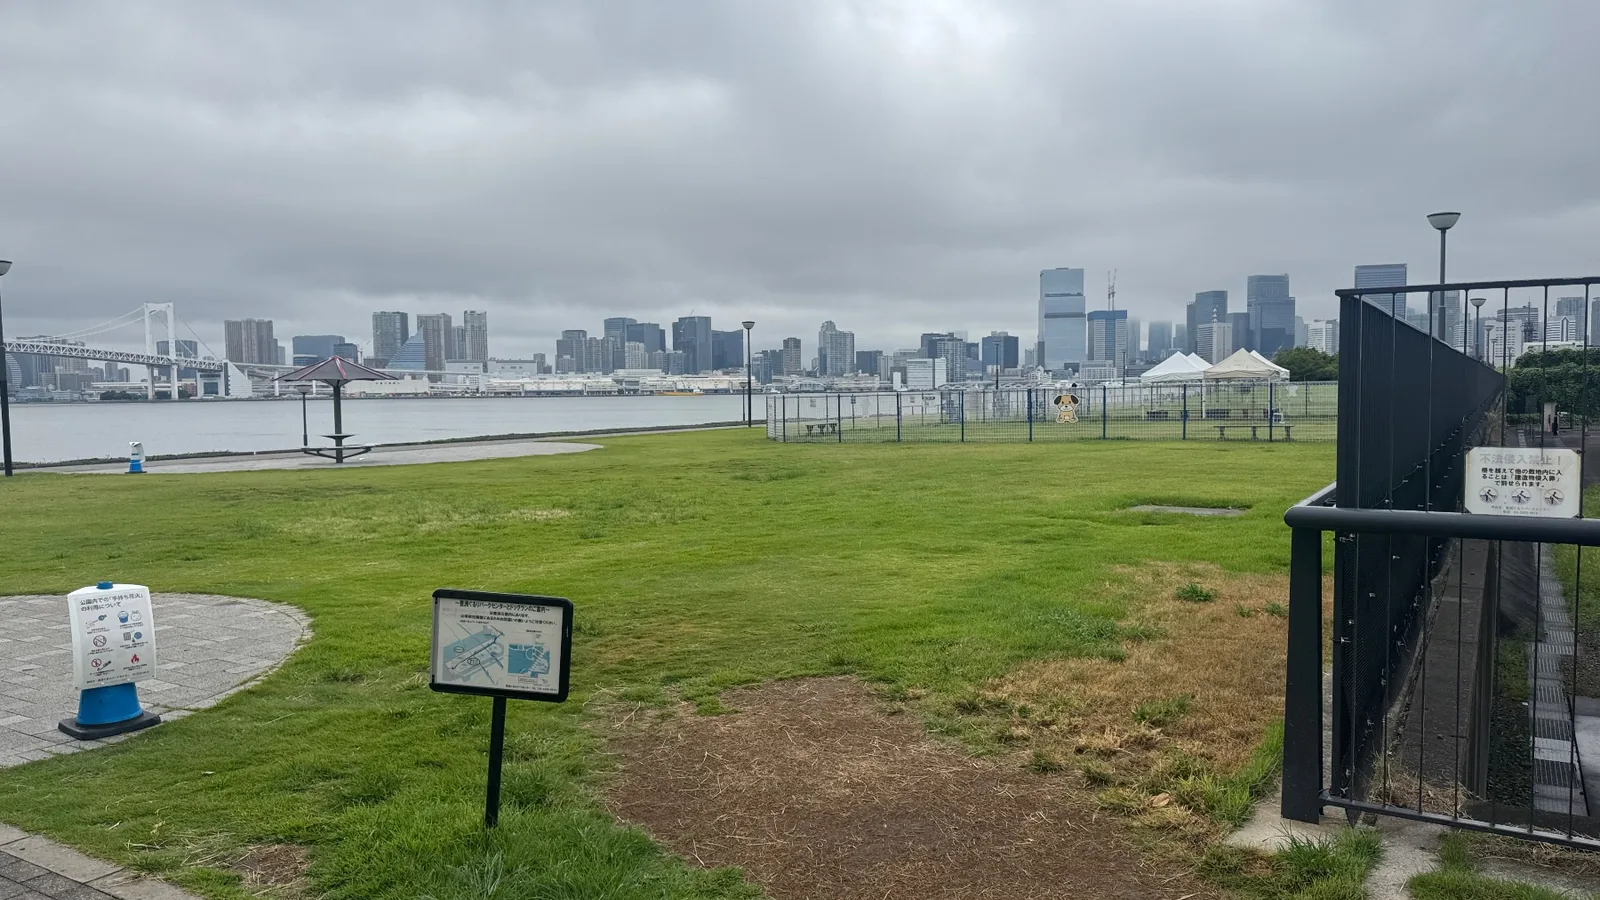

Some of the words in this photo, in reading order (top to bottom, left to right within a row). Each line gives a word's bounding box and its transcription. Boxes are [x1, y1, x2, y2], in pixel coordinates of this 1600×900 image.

[80, 602, 122, 611] の利用について
